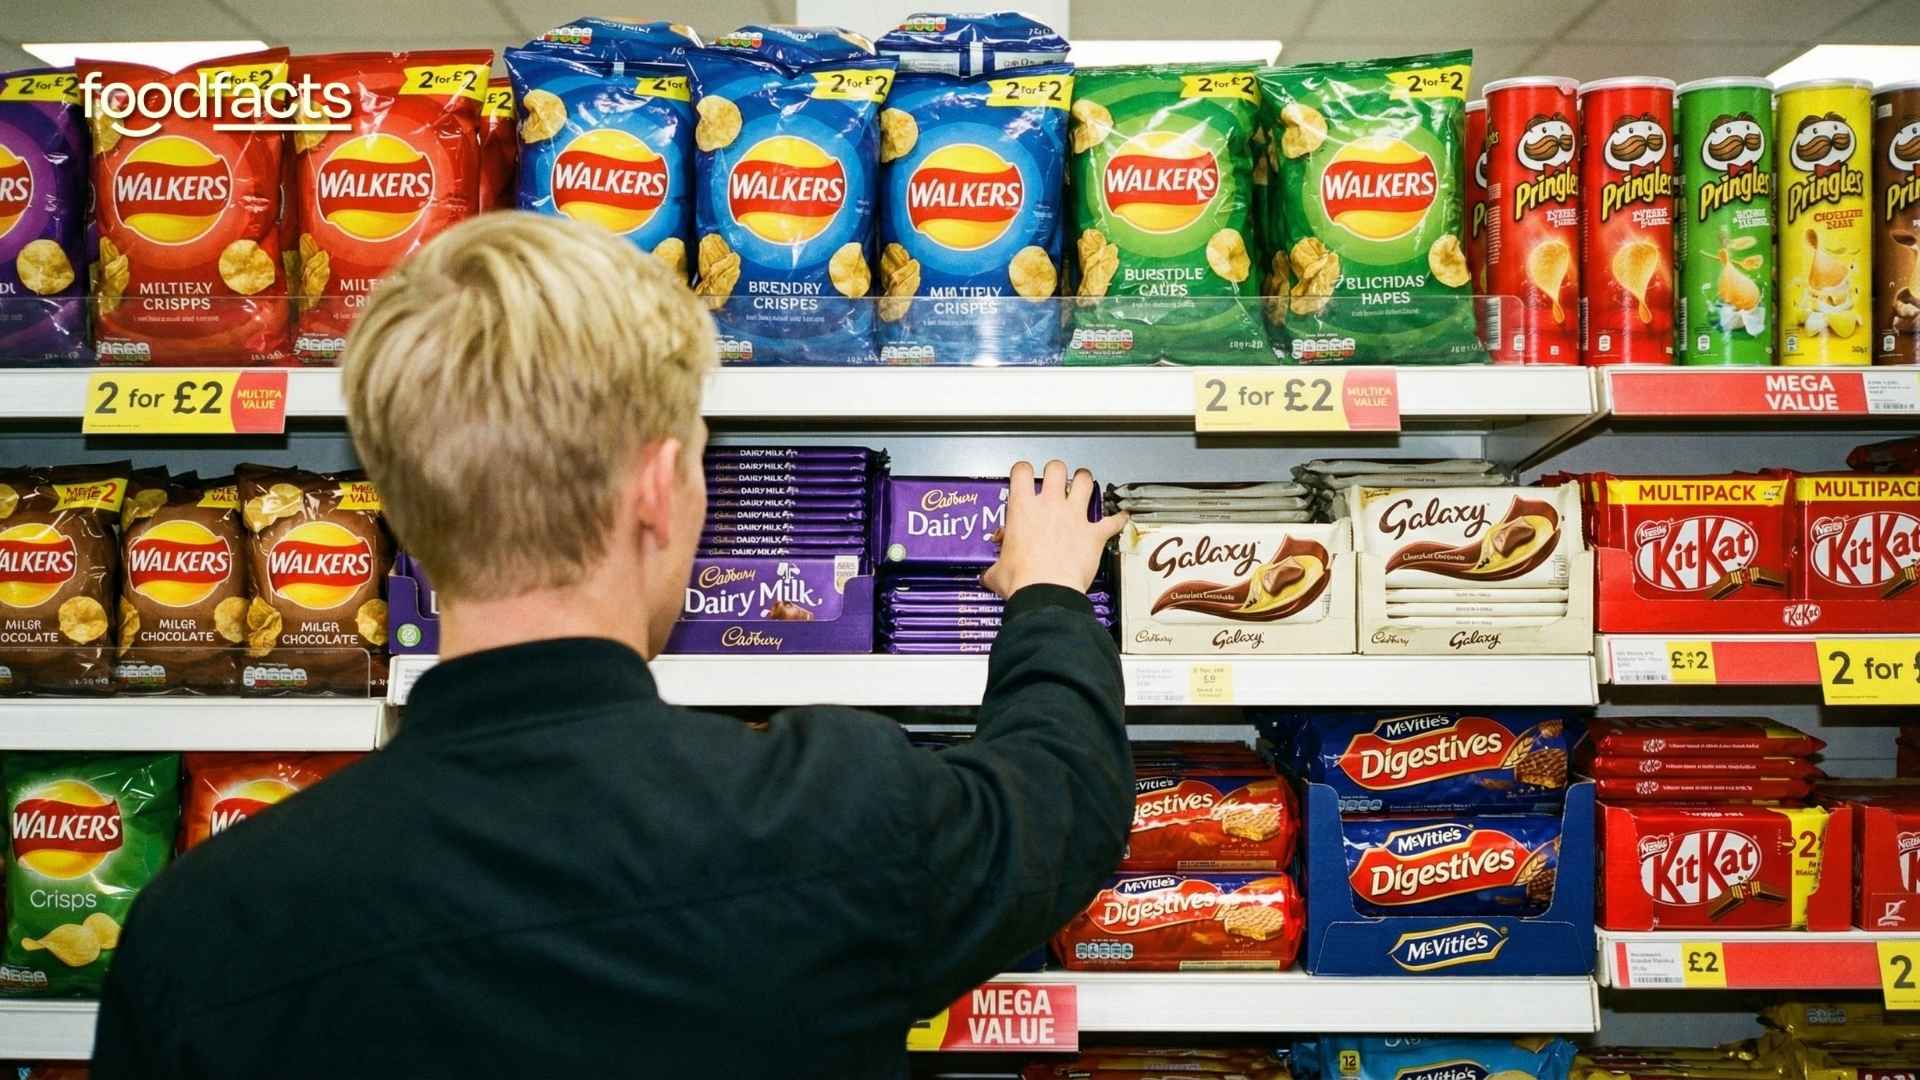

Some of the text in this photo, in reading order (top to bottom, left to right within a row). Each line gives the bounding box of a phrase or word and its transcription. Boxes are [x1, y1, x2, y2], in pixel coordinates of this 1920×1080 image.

[18, 78, 35, 94] 2
[419, 71, 434, 89] 2
[831, 74, 846, 93] 2
[1006, 81, 1020, 99] 2
[1198, 78, 1212, 93] 2
[1407, 75, 1423, 92] 2
[116, 175, 229, 201] WALKERS
[319, 171, 431, 199] WALKERS
[556, 161, 667, 197] WALKERS
[732, 171, 844, 203] WALKERS
[1106, 165, 1217, 194] WALKERS
[1324, 171, 1435, 200] WALKERS
[911, 179, 1022, 208] WALKERS
[1601, 165, 1672, 222] Pringles
[1699, 165, 1771, 223] Pringles
[1788, 163, 1864, 224] Pringles
[95, 380, 223, 414] 2 for £2
[1205, 378, 1334, 412] 2 for £2
[1765, 374, 1835, 392] MEGA
[242, 399, 276, 409] VALUE
[1765, 394, 1839, 411] VALUE
[1638, 484, 1756, 501] MULTIPACK
[907, 511, 978, 540] Dairy
[1378, 497, 1492, 540] Galaxy
[131, 549, 229, 573] WALKERS
[270, 551, 370, 575] WALKERS
[1148, 535, 1263, 579] Galaxy
[1652, 517, 1750, 589] KitKat
[685, 586, 755, 617] Dairy
[0, 631, 59, 642] OCOLATE
[141, 631, 214, 642] CHOCOLATE
[282, 633, 358, 645] CHOCOLATE
[721, 625, 783, 650] Cadbury
[1212, 629, 1264, 649] Galaxy
[1449, 630, 1502, 650] Galaxy
[1828, 650, 1903, 685] 2 for
[1359, 731, 1503, 780] Digestives
[1136, 779, 1174, 791] Vitie's
[1136, 791, 1214, 824] estives
[13, 809, 120, 842] WALKERS
[1398, 827, 1462, 853] McVitie's
[1800, 830, 1817, 858] 2
[1370, 848, 1516, 896] Digestives
[1652, 831, 1753, 905] KitKat
[30, 889, 97, 912] Crisps
[1104, 889, 1216, 926] Digestives
[1406, 930, 1489, 962] McVitie's
[1688, 951, 1719, 973] £2
[1889, 955, 1916, 989] 2
[972, 989, 1052, 1015] MEGA
[968, 1018, 1056, 1045] VALUE
